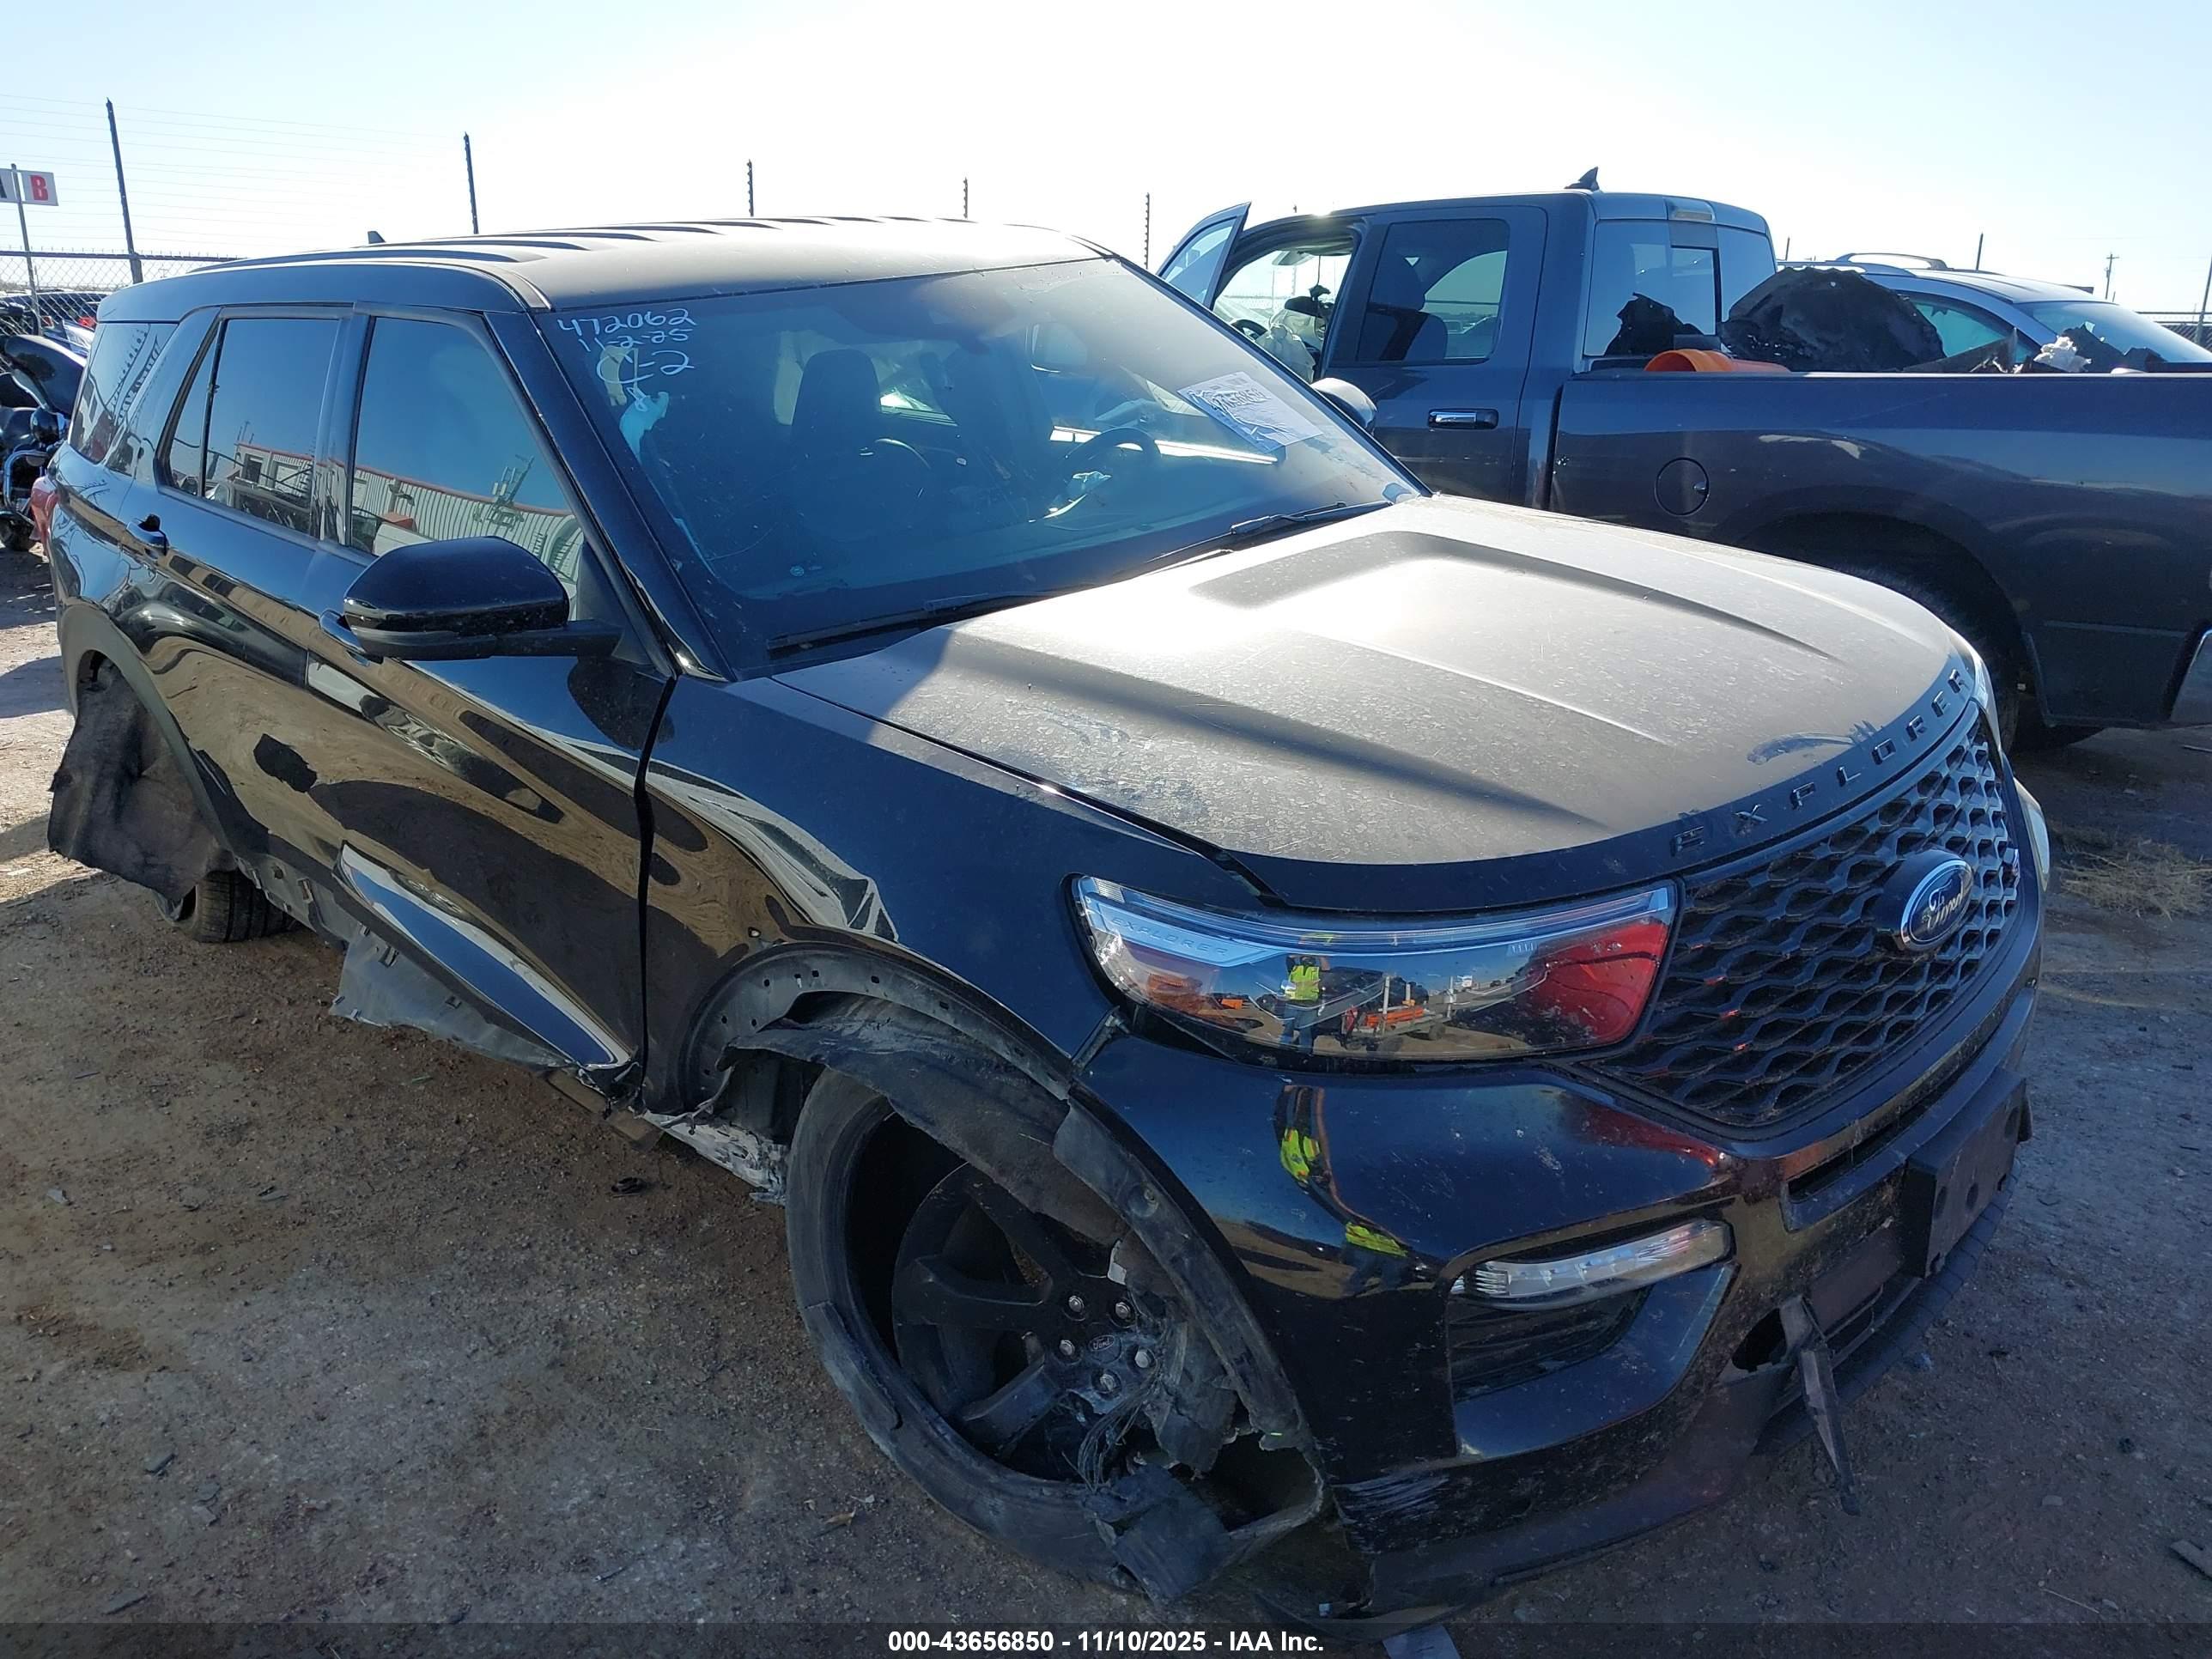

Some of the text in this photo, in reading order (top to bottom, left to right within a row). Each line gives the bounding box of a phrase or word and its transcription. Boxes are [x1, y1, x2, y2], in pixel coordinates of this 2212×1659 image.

[30, 175, 49, 200] B
[557, 308, 697, 337] 472062
[578, 328, 693, 352] 11-2-25
[1670, 668, 1966, 857] EXPLORER
[1922, 874, 1963, 931] Ford
[1111, 917, 1228, 955] EXPLORER
